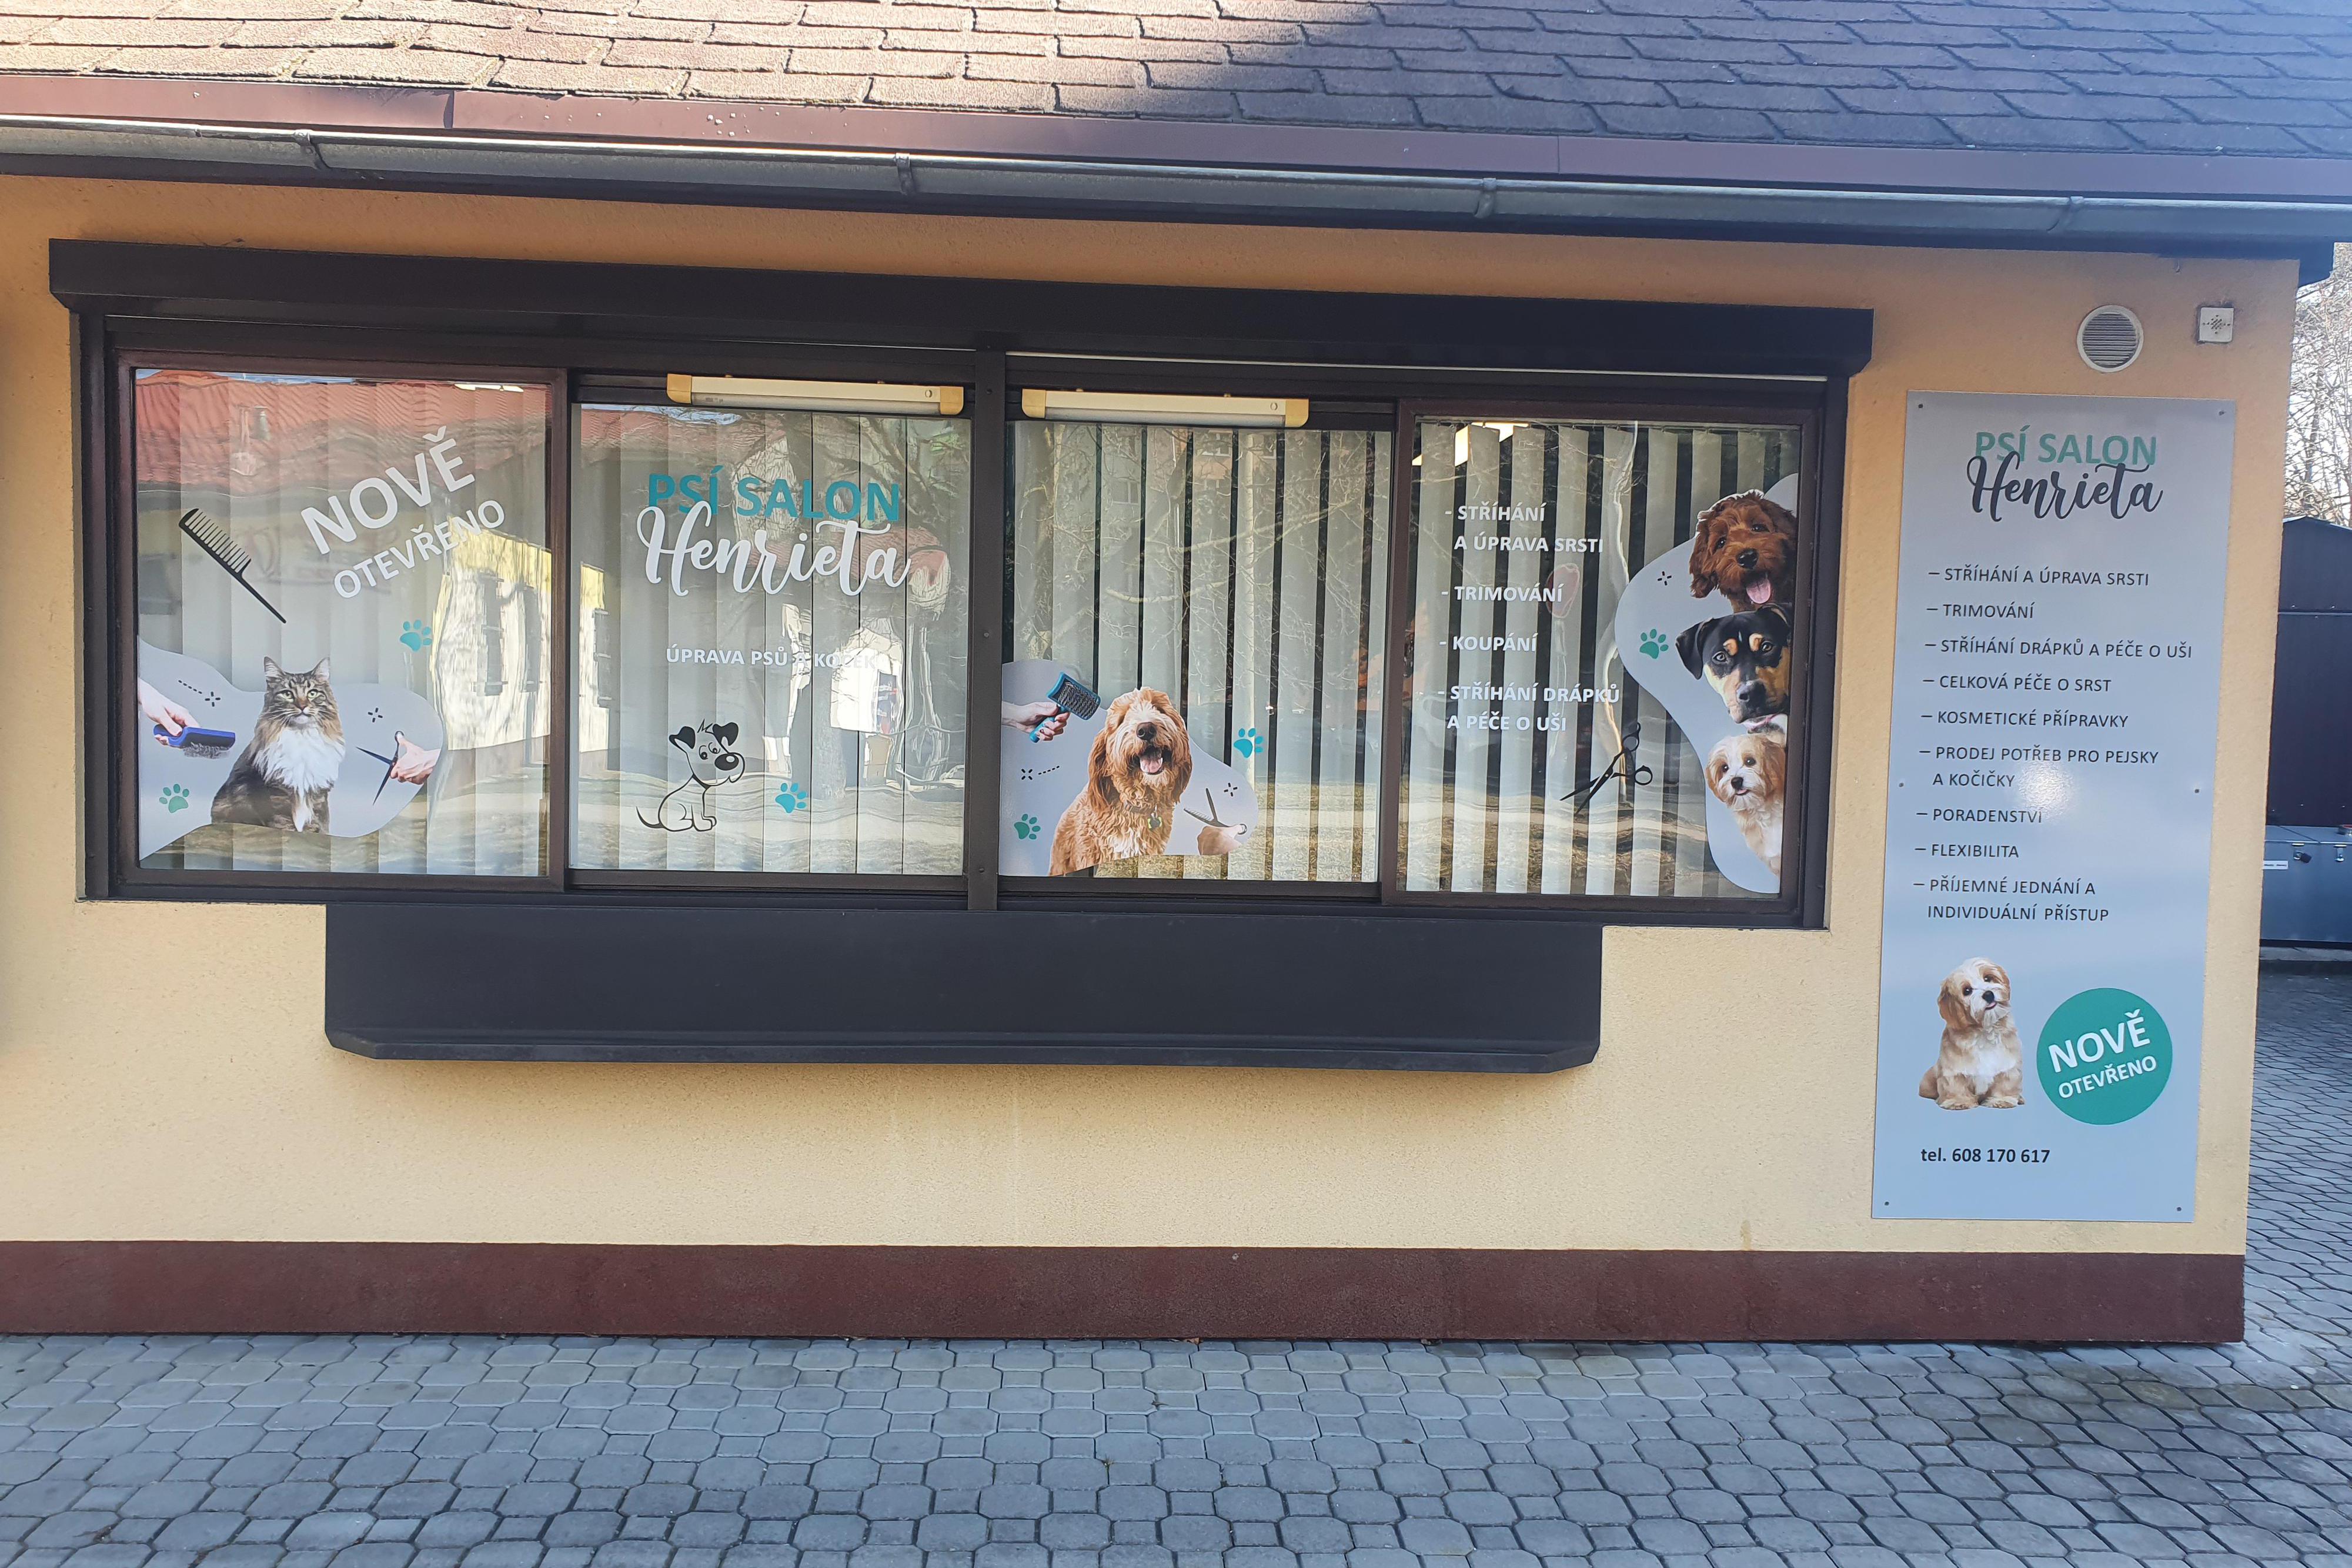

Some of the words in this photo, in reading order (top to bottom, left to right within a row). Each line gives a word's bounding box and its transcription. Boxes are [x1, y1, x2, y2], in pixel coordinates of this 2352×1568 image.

[1975, 424, 2031, 462] PSÍ
[2037, 433, 2157, 466] SALON
[300, 425, 476, 554] NOVĚ
[648, 465, 724, 515] PSÍ
[737, 477, 900, 521] SALON
[1966, 451, 2164, 522] Henrieta
[1457, 501, 1547, 522] STŘÍHÁNÍ
[333, 500, 505, 599] OTEVŘENO
[637, 501, 911, 596] Henrieta
[1454, 536, 1467, 551] A
[1473, 531, 1549, 552] ÚPRAVA
[1554, 539, 1603, 553] SRSTI
[1944, 564, 2018, 583] STŘÍHÁNÍ
[2023, 570, 2034, 583] A
[2039, 566, 2102, 585] ÚPRAVA
[2106, 572, 2149, 586] SRSTI
[1454, 583, 1565, 603] TRIMOVÁNÍ
[1943, 602, 2035, 619] TRIMOVÁNÍ
[1452, 633, 1538, 652] KOUPÁNÍ
[1940, 636, 2014, 654] STŘÍHÁNÍ
[2020, 638, 2084, 656] DRÁPKŮ
[2089, 644, 2100, 657] A
[2106, 640, 2143, 657] PÉČE
[2149, 644, 2160, 658] O
[2166, 641, 2192, 658] UŠI
[666, 644, 745, 666] ÚPRAVA
[751, 647, 788, 666] PSŮ
[795, 655, 808, 667] A
[1449, 681, 1539, 701] STŘÍHÁNÍ
[1543, 683, 1619, 703] DRÁPKŮ
[1939, 673, 2009, 690] CELKOVÁ
[2014, 673, 2052, 691] PÉČE
[2057, 677, 2069, 691] O
[2074, 679, 2112, 692] SRST
[1446, 714, 1460, 730] A
[1466, 711, 1509, 730] PÉČE
[1516, 715, 1530, 730] O
[1536, 711, 1566, 731] UŠI
[1937, 709, 2036, 726] KOSMETICKÉ
[2043, 710, 2129, 728] PŘÍPRAVKY
[1936, 747, 1995, 761] PRODEJ
[2001, 744, 2062, 762] POTŘEB
[2067, 750, 2099, 763] PRO
[2106, 750, 2159, 764] PEJSKY
[1932, 773, 1943, 787] A
[1949, 770, 2016, 788] KOČIČKY
[1932, 844, 2019, 858] FLEXIBILITA
[1929, 875, 2007, 893] PŘÍJEMNÉ
[2012, 878, 2080, 894] JEDNÁNÍ
[2085, 882, 2096, 895] A
[1927, 904, 2036, 920] INDIVIDUÁLNÍ
[2044, 904, 2109, 922] PŘÍSTUP
[2047, 1008, 2151, 1072] NOVĚ
[2057, 1055, 2157, 1099] OTEVŘENO
[1920, 1148, 1947, 1162] tel.
[1952, 1148, 1982, 1162] 608
[1986, 1149, 2016, 1163] 170
[2020, 1149, 2050, 1163] 617
